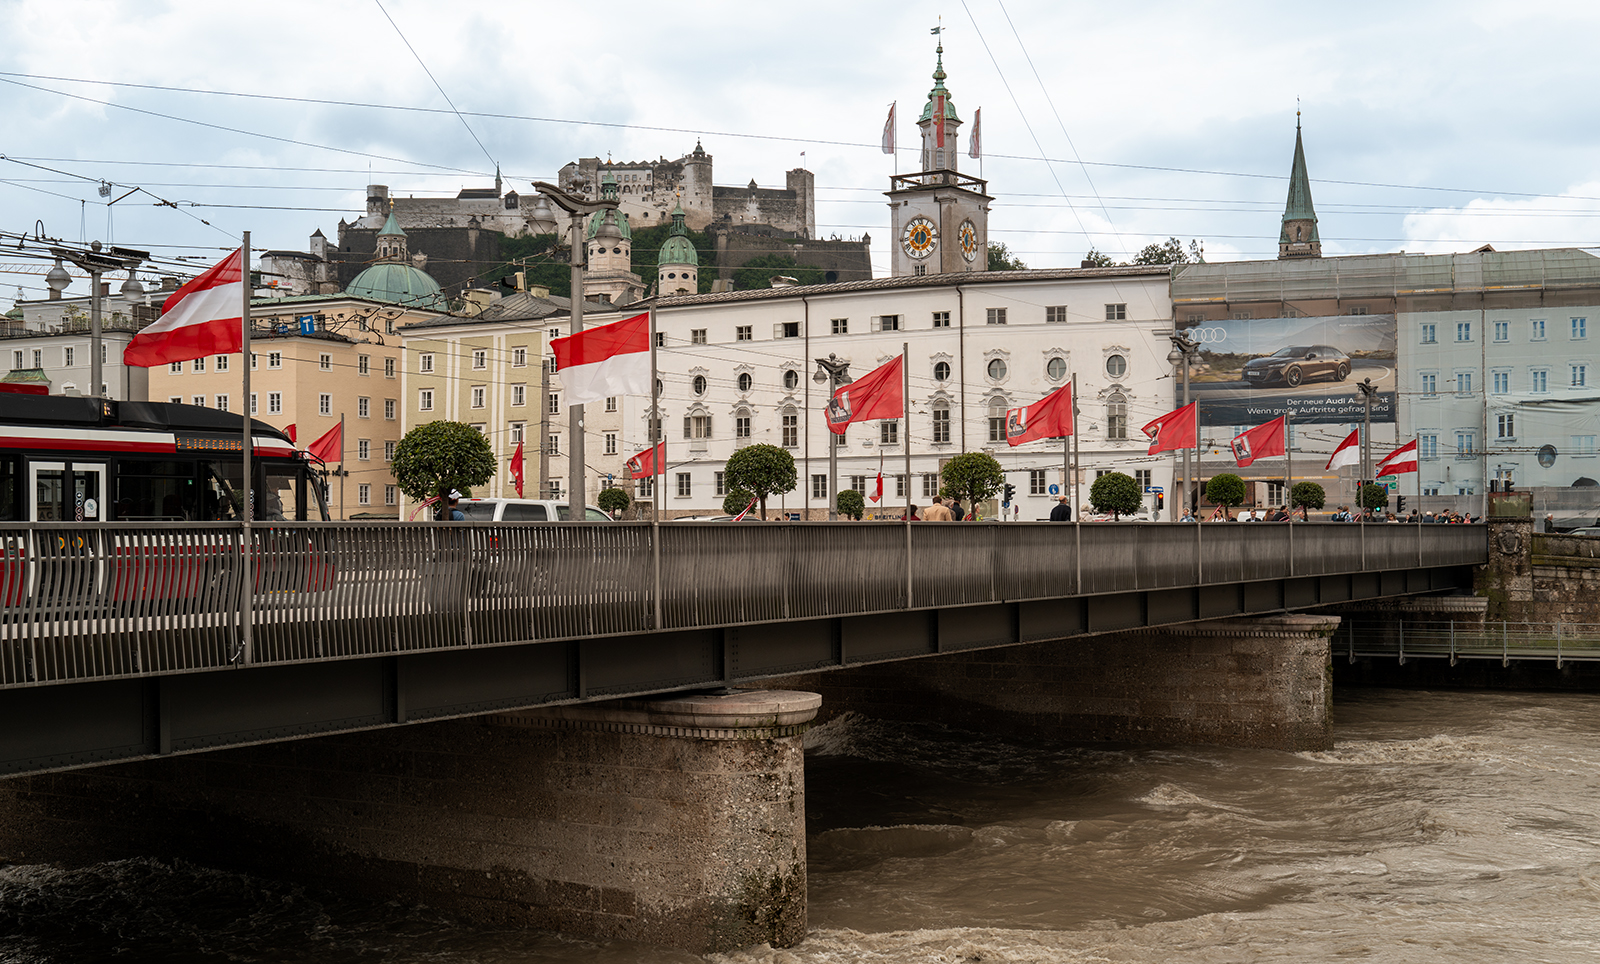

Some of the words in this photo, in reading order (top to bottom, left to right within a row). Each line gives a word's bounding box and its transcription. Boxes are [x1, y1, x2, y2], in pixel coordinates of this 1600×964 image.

[1247, 407, 1272, 415] Wenn
[1300, 405, 1337, 413] Auftritte
[1338, 405, 1366, 413] gefrag
[1371, 404, 1389, 412] sind
